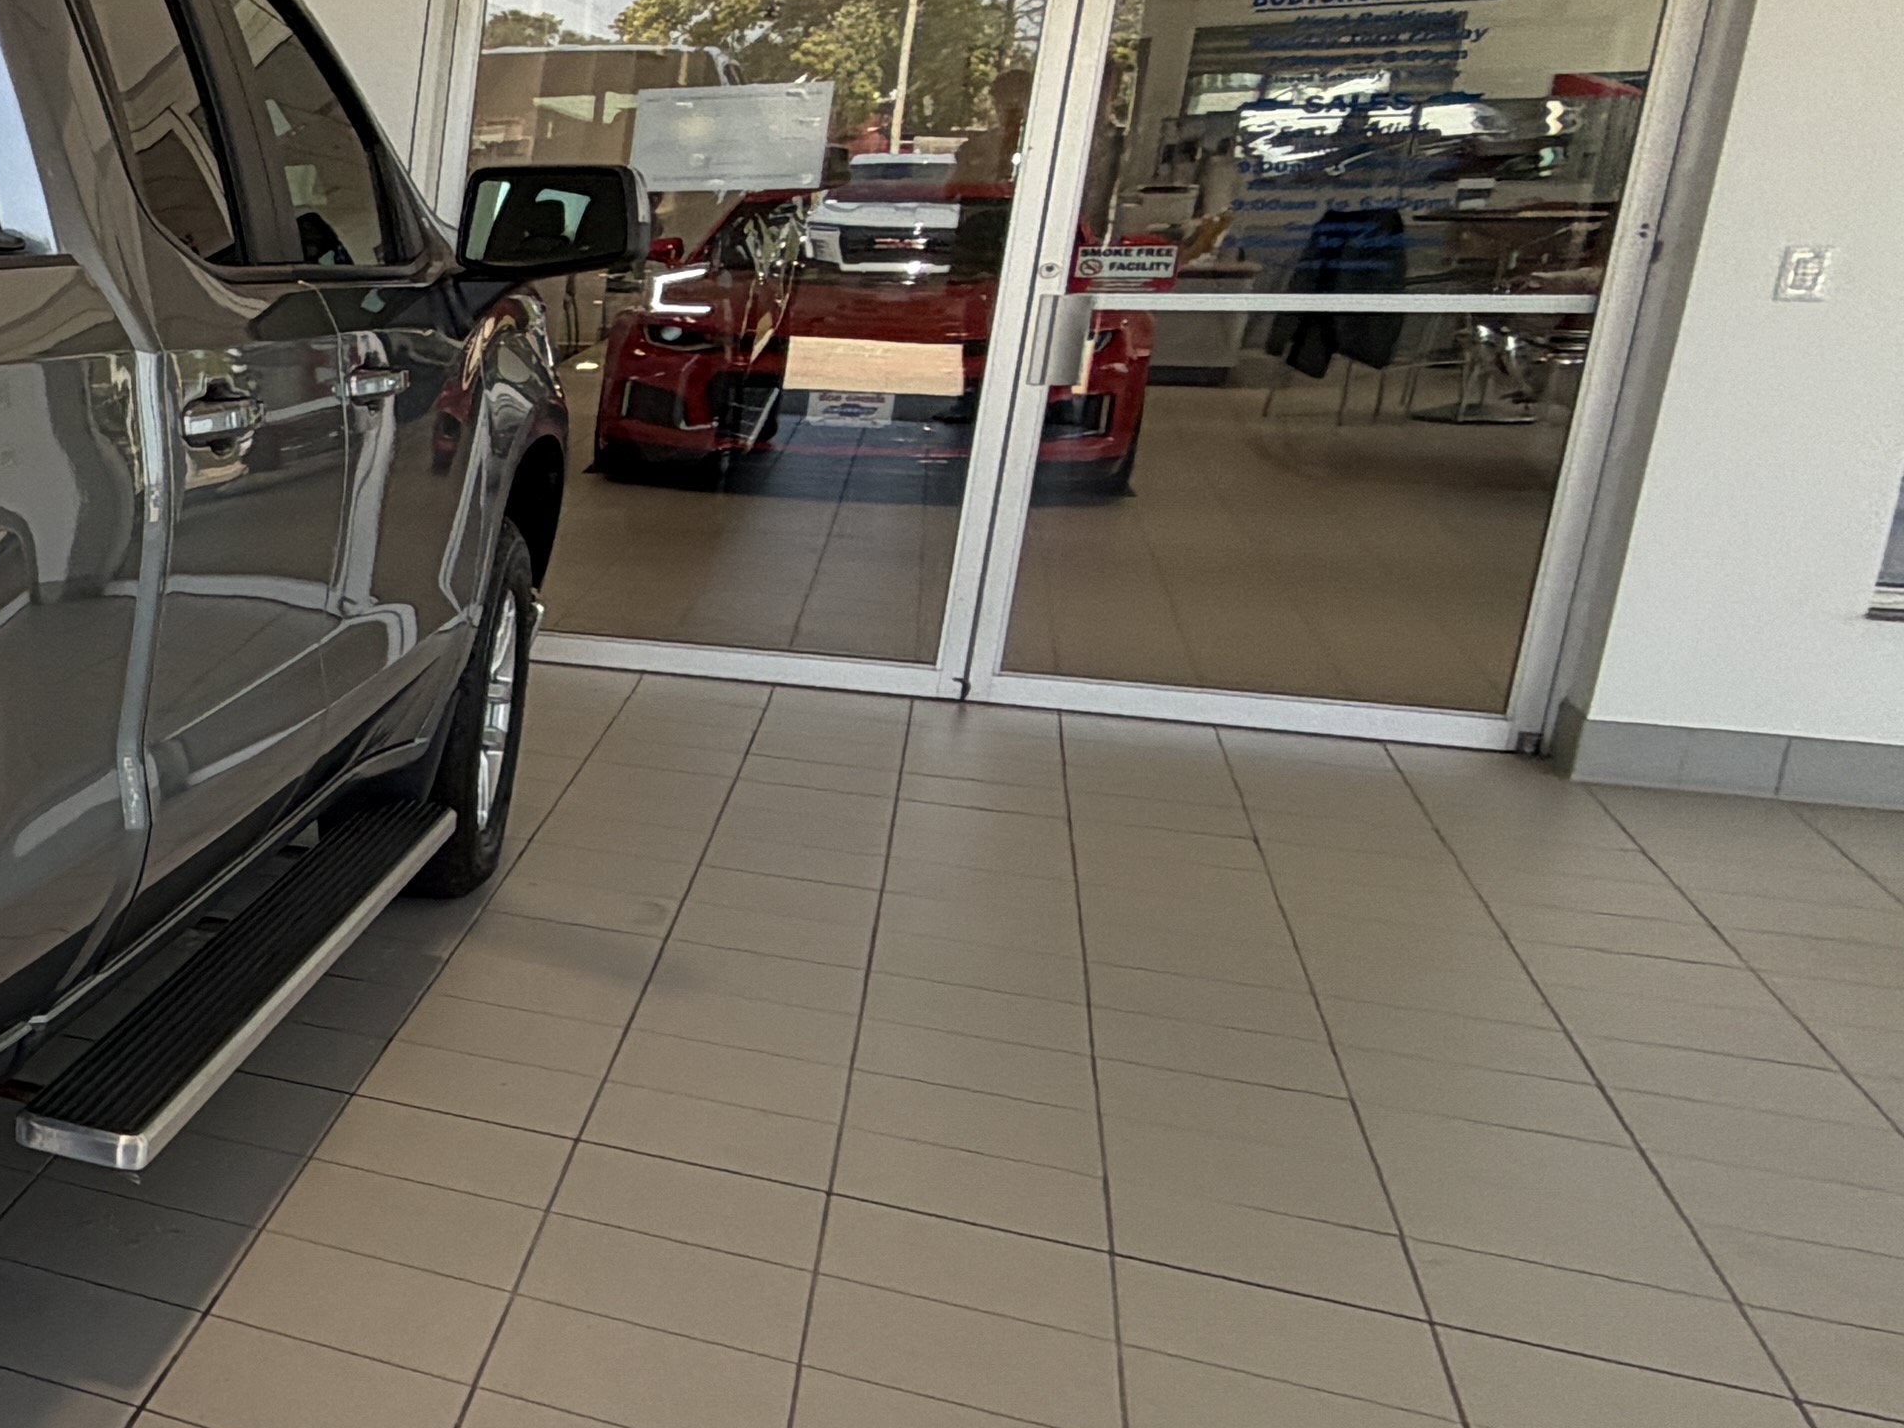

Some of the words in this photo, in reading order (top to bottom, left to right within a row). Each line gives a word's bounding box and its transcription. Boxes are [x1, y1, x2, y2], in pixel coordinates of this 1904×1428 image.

[1080, 248, 1133, 258] SMOKE
[1136, 247, 1173, 257] FREE
[1108, 261, 1172, 272] FACILITY
